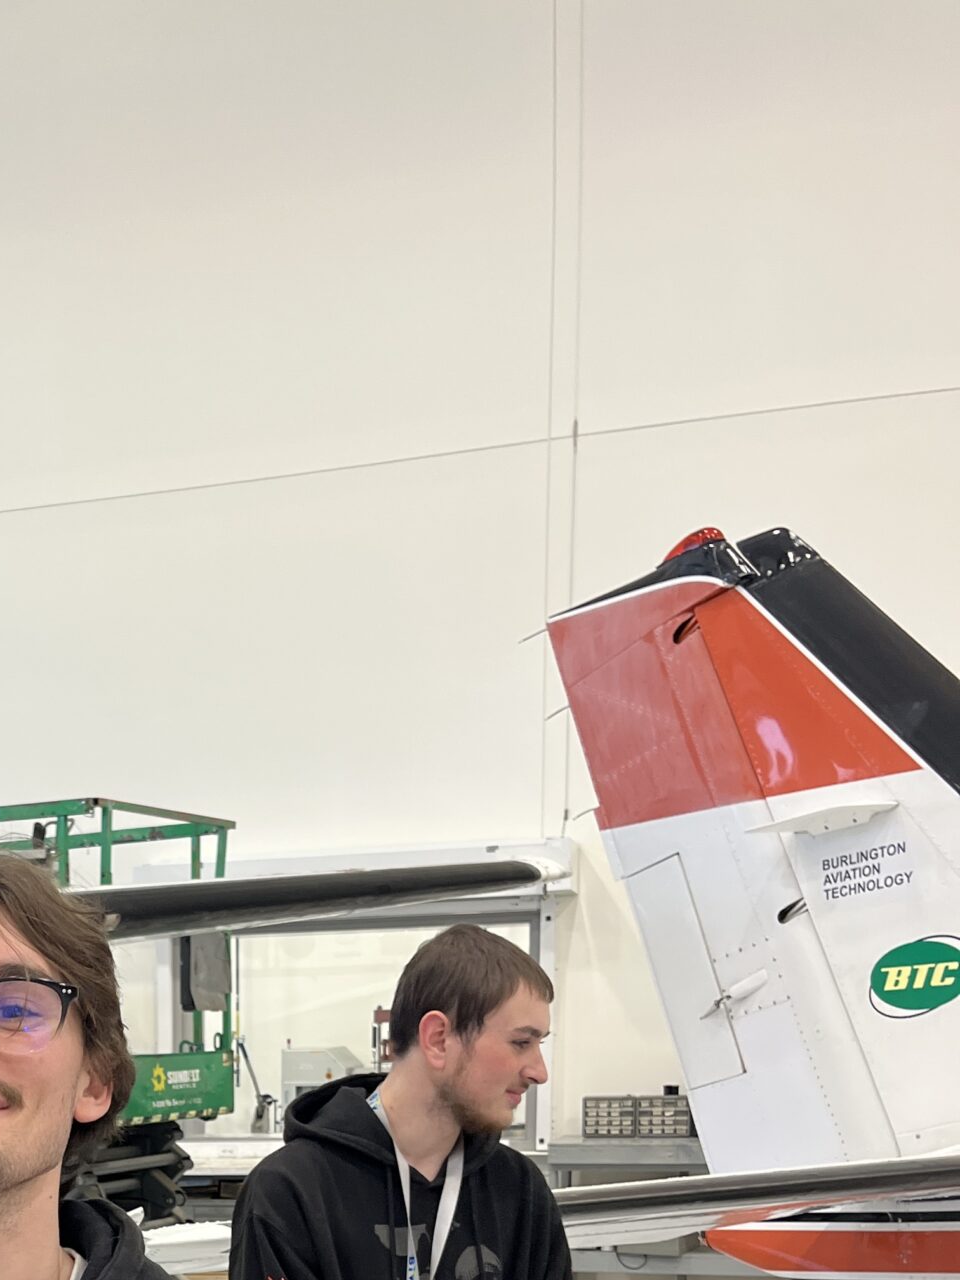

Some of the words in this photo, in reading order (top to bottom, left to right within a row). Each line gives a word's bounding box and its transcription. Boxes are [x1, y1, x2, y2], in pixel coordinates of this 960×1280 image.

[822, 841, 906, 872] BURLINGTON
[823, 863, 881, 886] AVIATION
[824, 870, 913, 901] TECHNOLOGY
[880, 961, 959, 991] BTC
